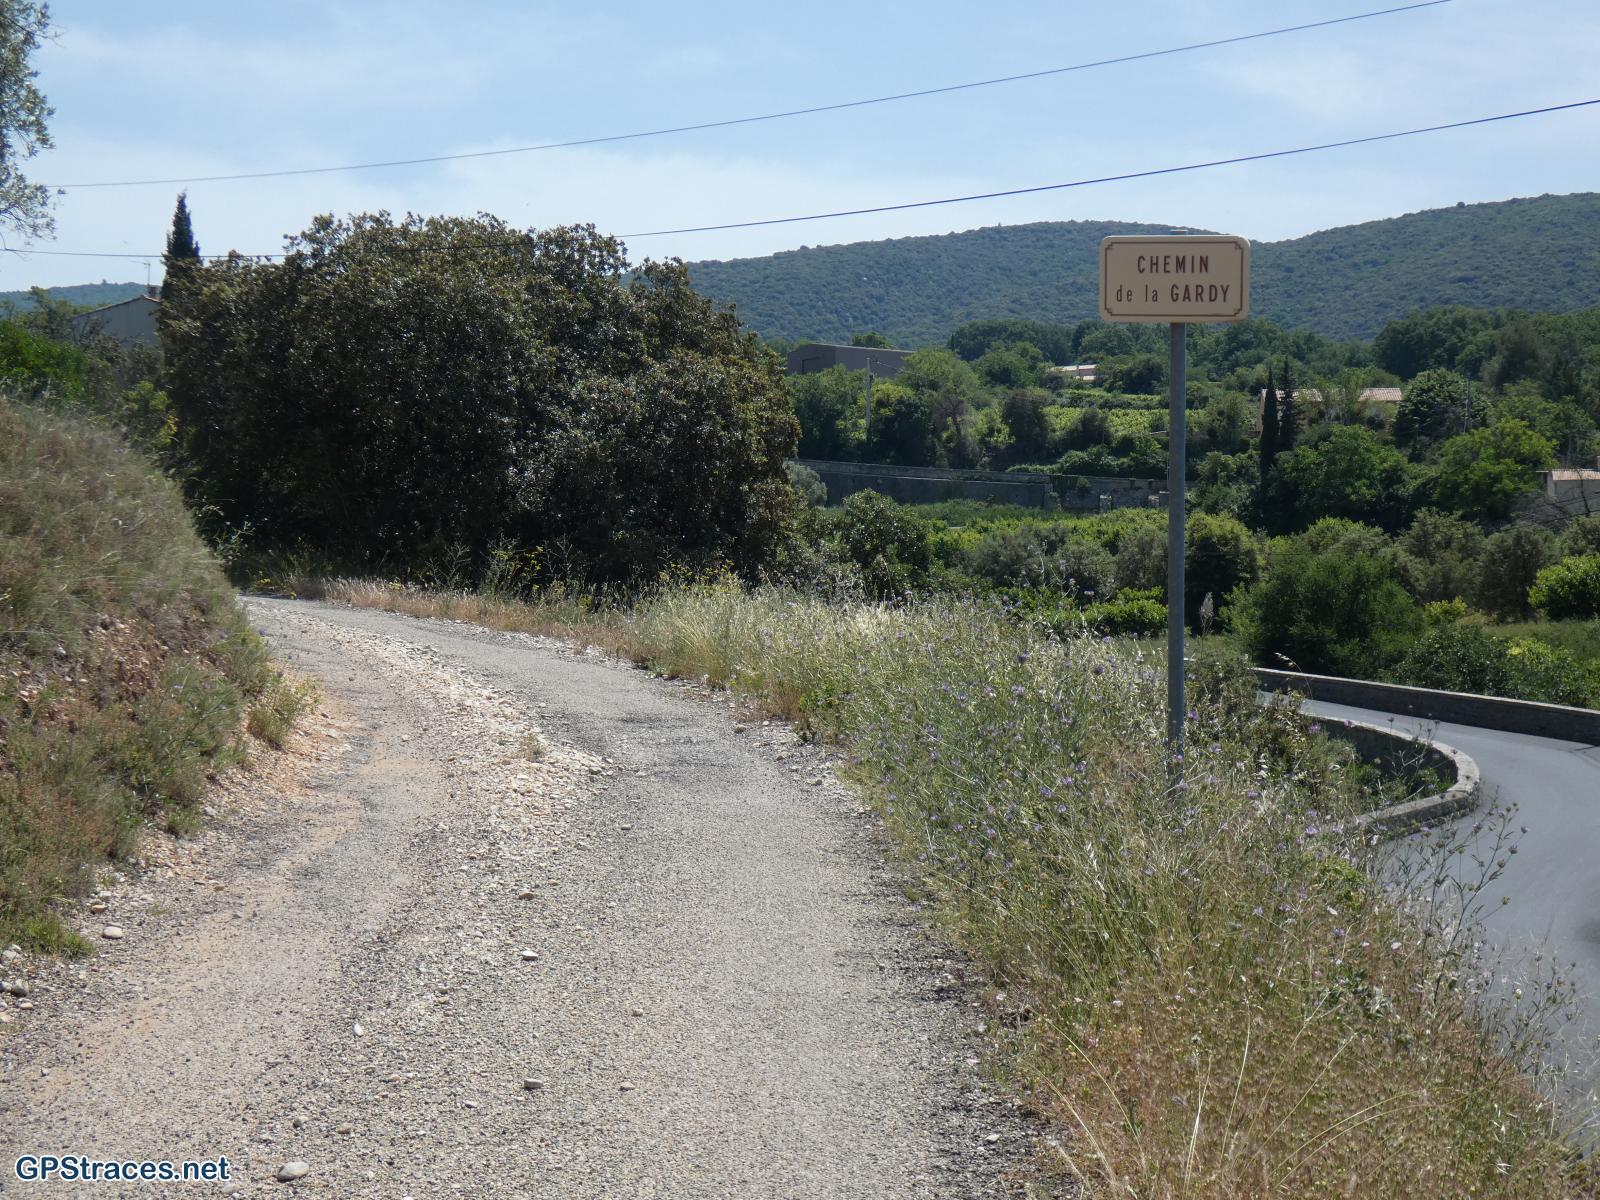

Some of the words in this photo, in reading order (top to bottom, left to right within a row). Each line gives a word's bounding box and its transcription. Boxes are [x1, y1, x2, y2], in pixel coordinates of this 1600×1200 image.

[1137, 255, 1209, 274] CHEMIN
[1116, 284, 1133, 303] de
[1145, 284, 1159, 303] la
[1170, 283, 1230, 303] GARDY
